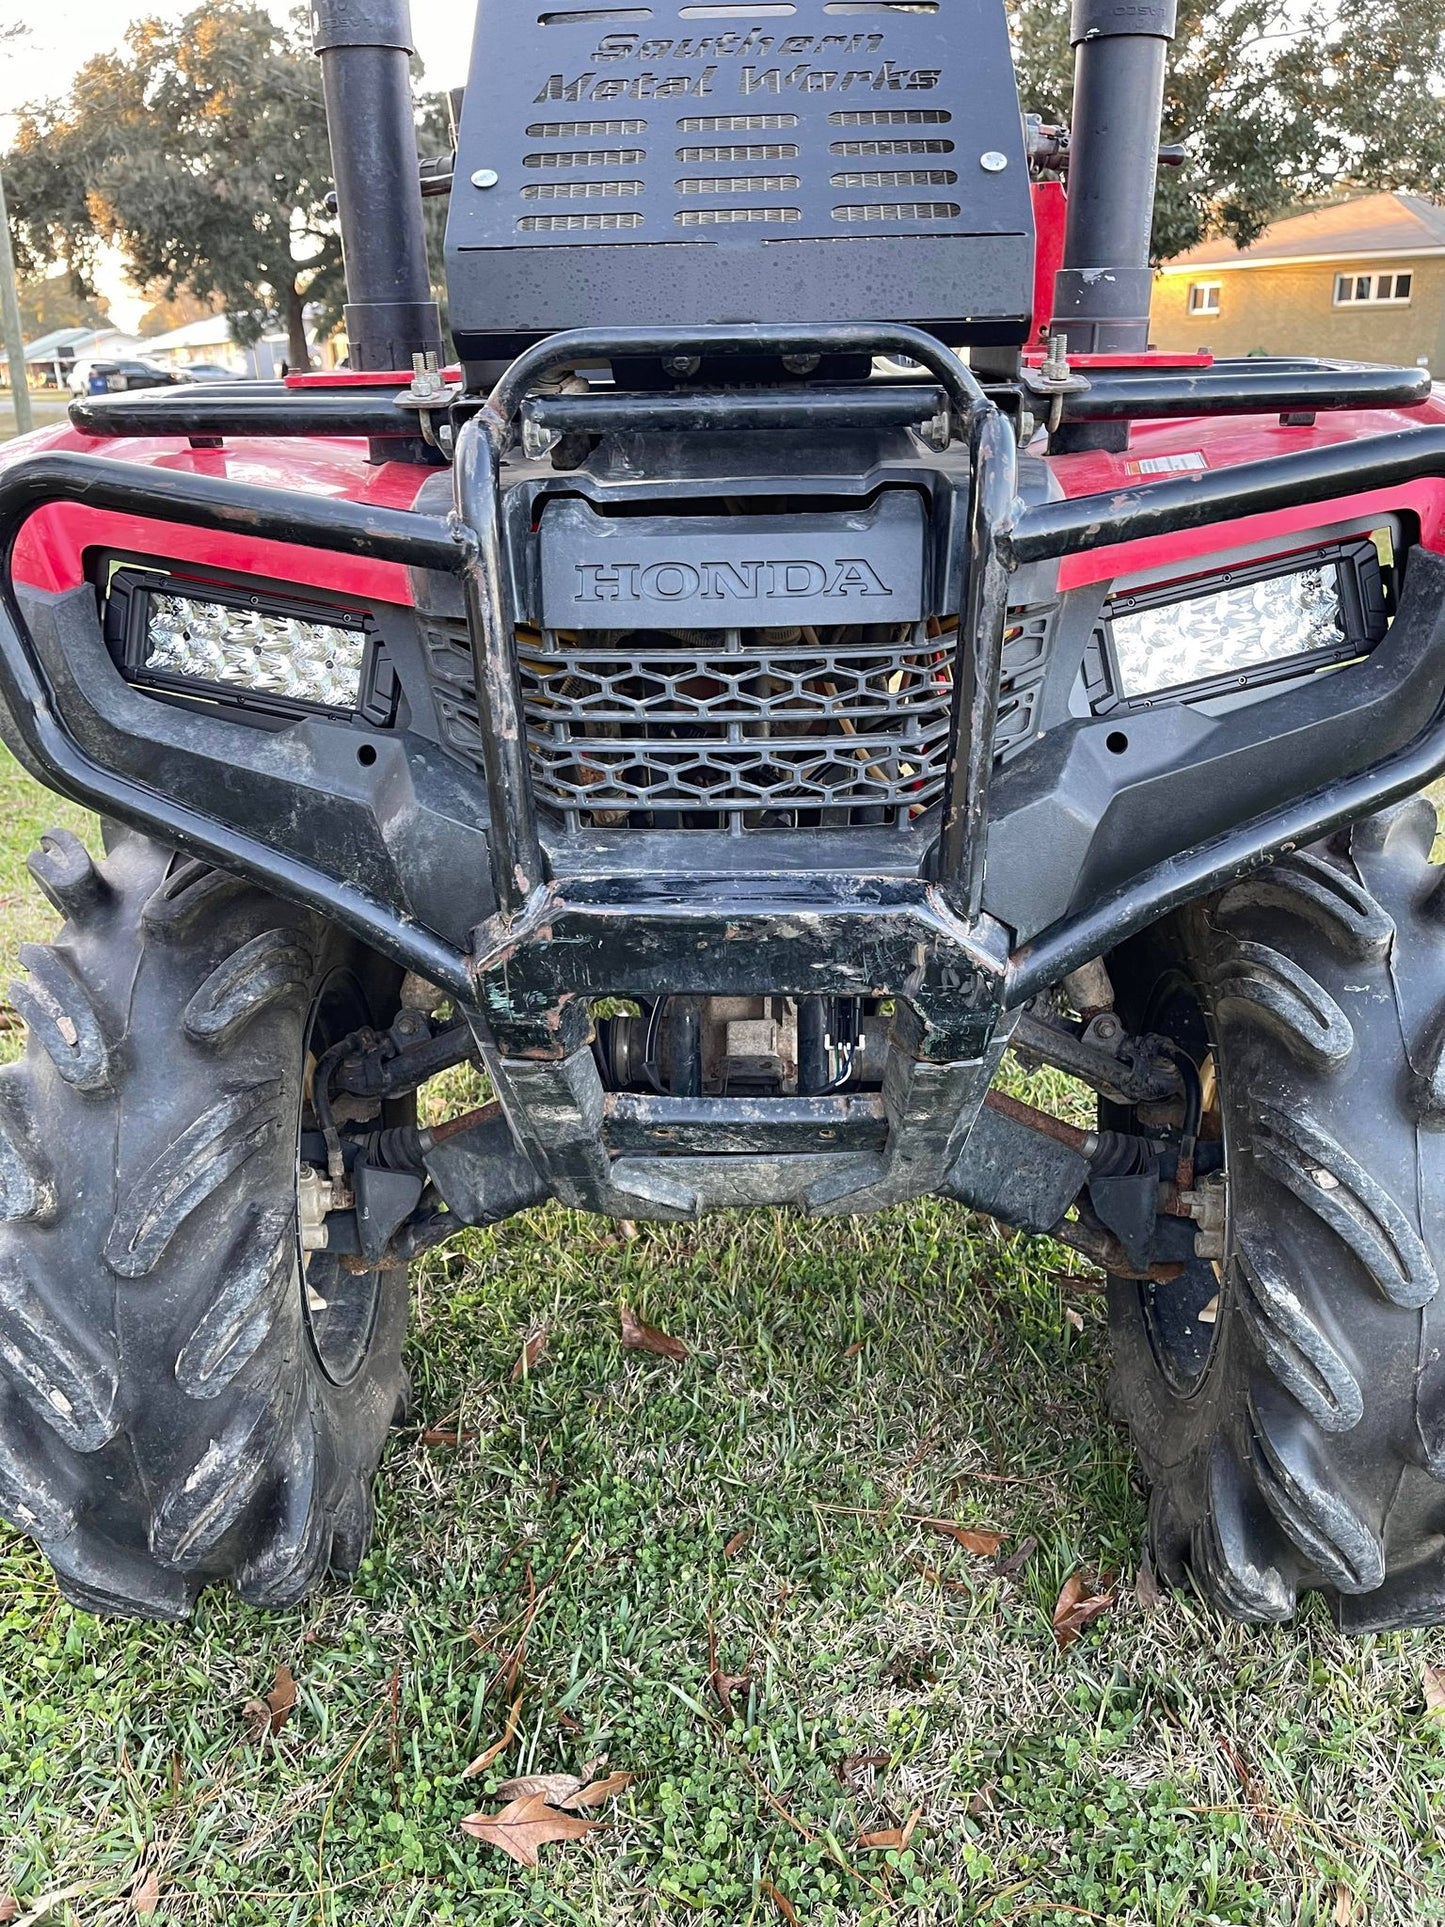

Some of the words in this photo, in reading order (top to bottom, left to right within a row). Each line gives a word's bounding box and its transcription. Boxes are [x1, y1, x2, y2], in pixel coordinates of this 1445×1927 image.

[591, 27, 884, 62] Southern
[533, 65, 718, 103] Metal
[737, 61, 942, 96] Works
[574, 558, 893, 602] HONDA
